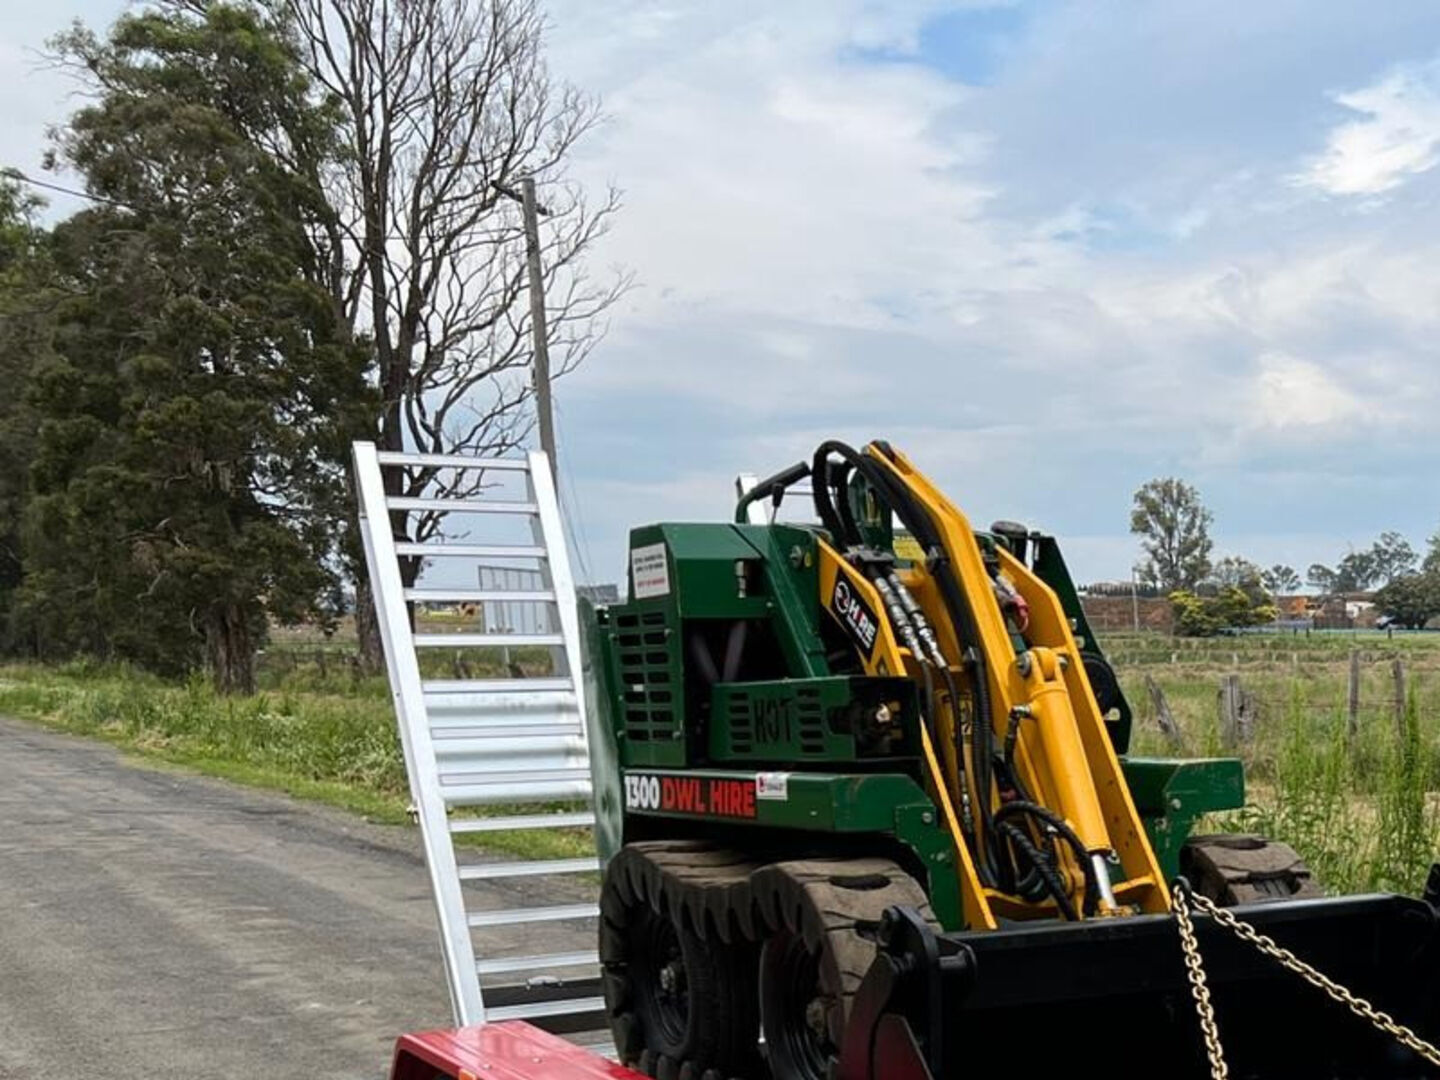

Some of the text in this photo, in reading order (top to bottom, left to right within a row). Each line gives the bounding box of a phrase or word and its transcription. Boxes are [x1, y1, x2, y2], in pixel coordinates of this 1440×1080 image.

[625, 775, 755, 816] 1300 DWL HIRE
